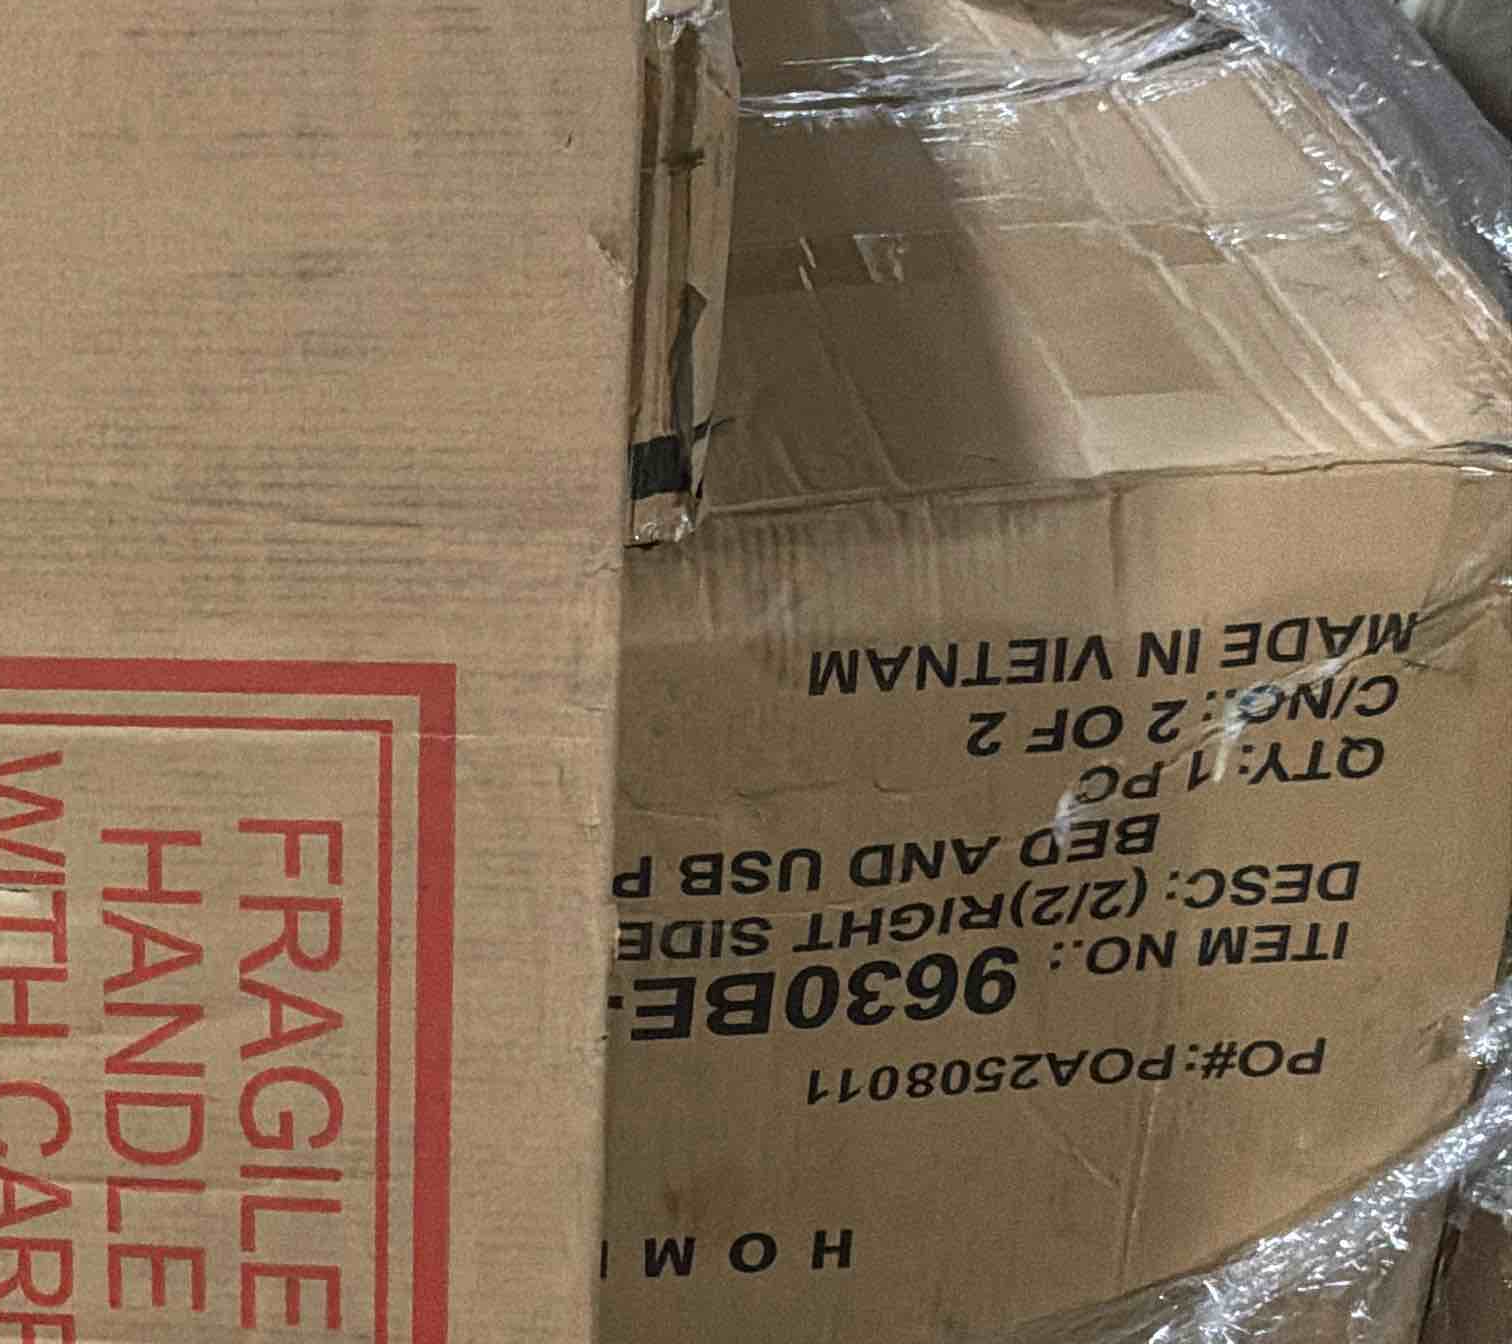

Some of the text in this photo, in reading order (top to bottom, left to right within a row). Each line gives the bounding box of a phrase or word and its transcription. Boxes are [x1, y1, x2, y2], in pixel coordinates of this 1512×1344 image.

[808, 612, 1419, 697] MADE IN VIETNAM
[965, 711, 1006, 757] 2
[1025, 705, 1124, 754] OF
[1147, 699, 1187, 745] 2
[1074, 736, 1385, 806] QTY: 1 PC
[849, 836, 1001, 887] AND
[1019, 813, 1160, 867] BED
[679, 848, 822, 896] USB
[1165, 860, 1361, 909] DESC:
[617, 917, 773, 961] SIDE
[1049, 929, 1177, 975] NO.:
[1198, 921, 1349, 967] ITEM
[100, 829, 205, 1312] HANDLE
[239, 819, 343, 1330] FRAGILE
[807, 1036, 1328, 1106] PO#:POA2508011
[599, 1228, 854, 1281] HOM
